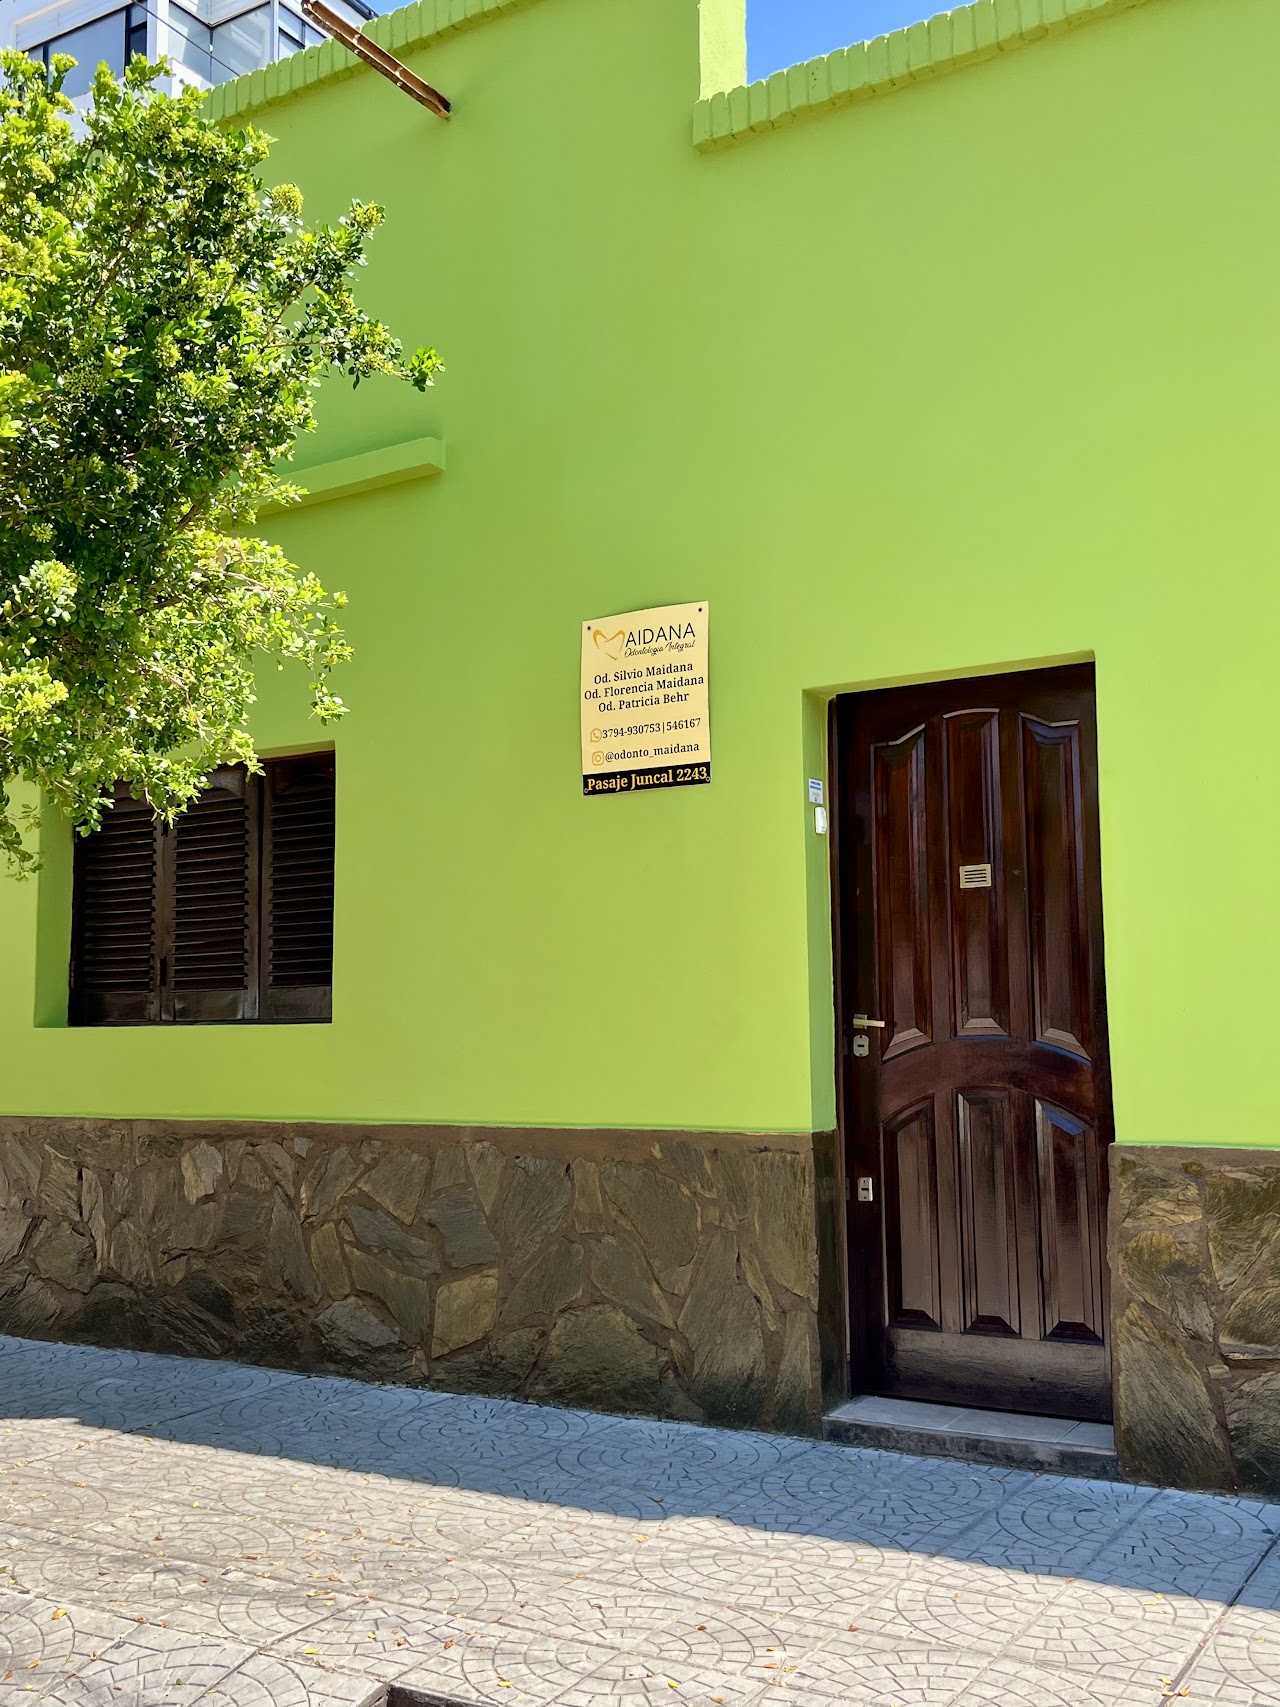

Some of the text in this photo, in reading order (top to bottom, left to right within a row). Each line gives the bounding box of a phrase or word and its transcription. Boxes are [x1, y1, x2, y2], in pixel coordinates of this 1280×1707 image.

[594, 663, 693, 684] Od. Silvio Maidana
[584, 676, 704, 700] Od. Florencia Maidana
[598, 692, 690, 712] Od. Patricia Behr
[605, 743, 700, 762] @odonto_maidana
[587, 766, 707, 791] Pasaje Juncal 2243
